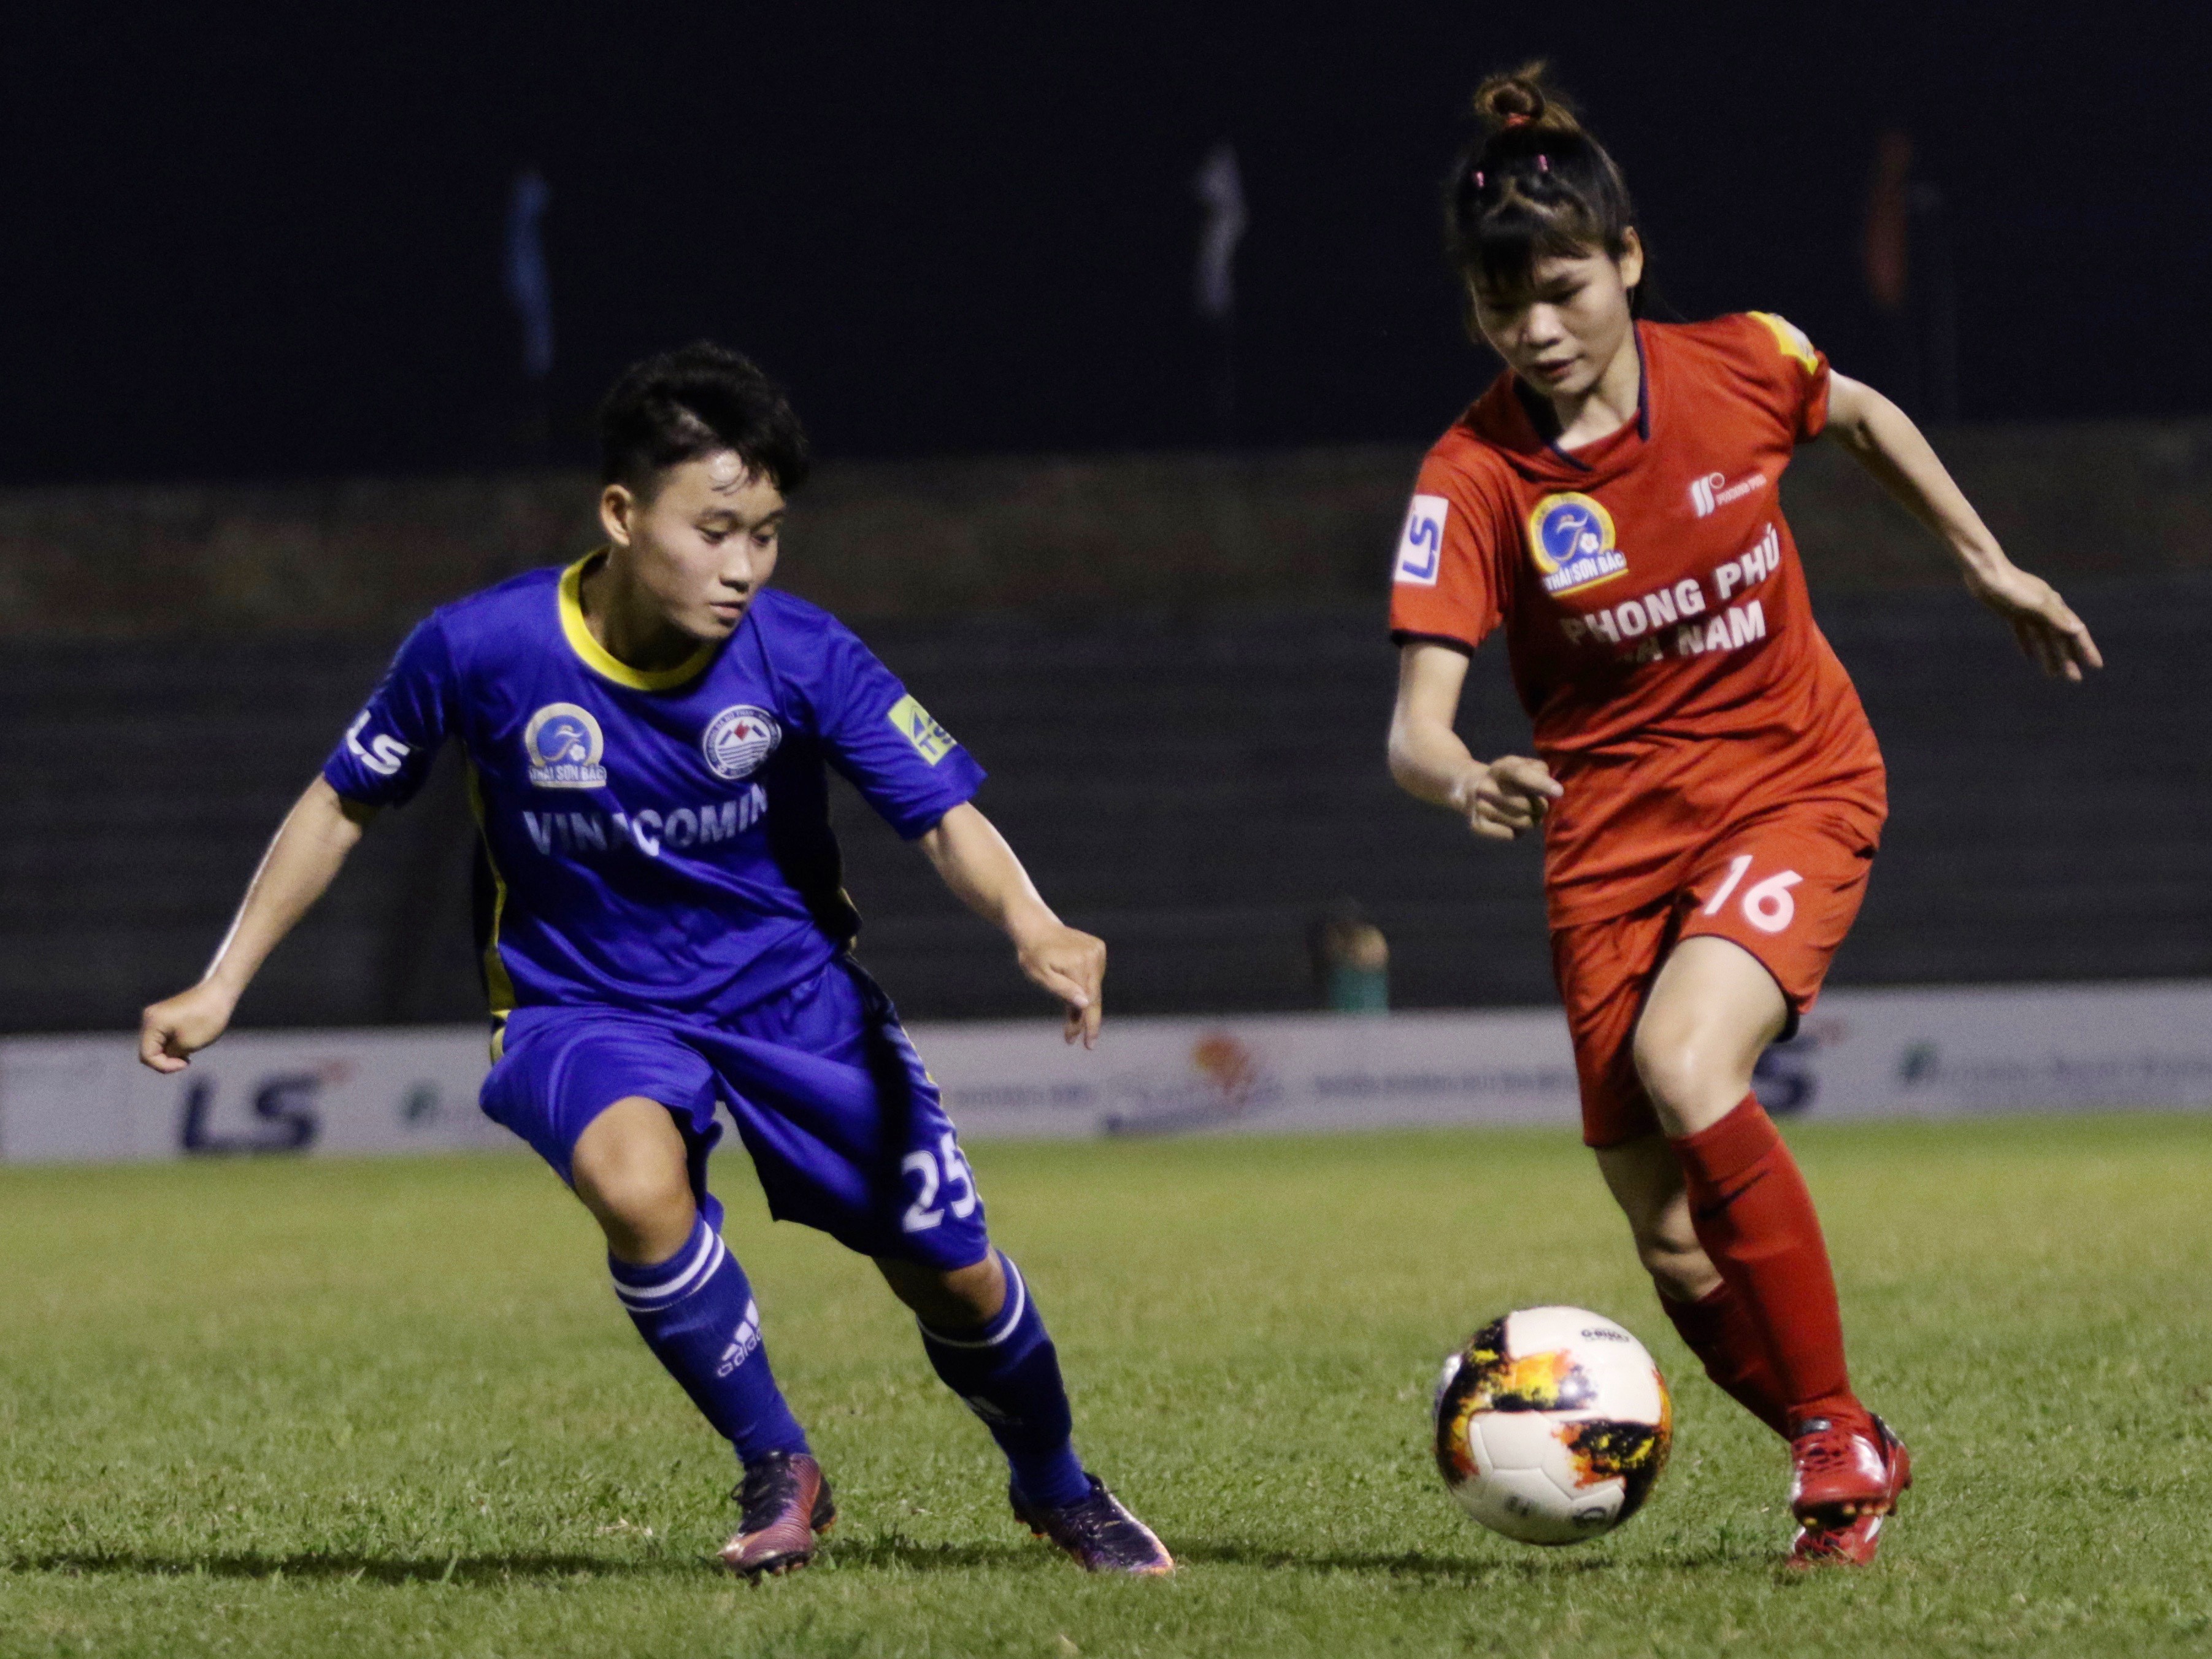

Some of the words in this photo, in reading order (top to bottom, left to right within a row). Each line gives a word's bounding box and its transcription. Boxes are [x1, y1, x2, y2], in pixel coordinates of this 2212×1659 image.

[1402, 514, 1439, 579] LS
[1561, 579, 1706, 645] PHONG
[1715, 522, 1779, 600] PHÚ
[1676, 599, 1767, 656] NAM
[345, 709, 410, 775] LS
[1705, 855, 1804, 933] 16
[180, 1071, 321, 1153] LS
[902, 1133, 977, 1233] 25
[717, 1326, 762, 1378] adid
